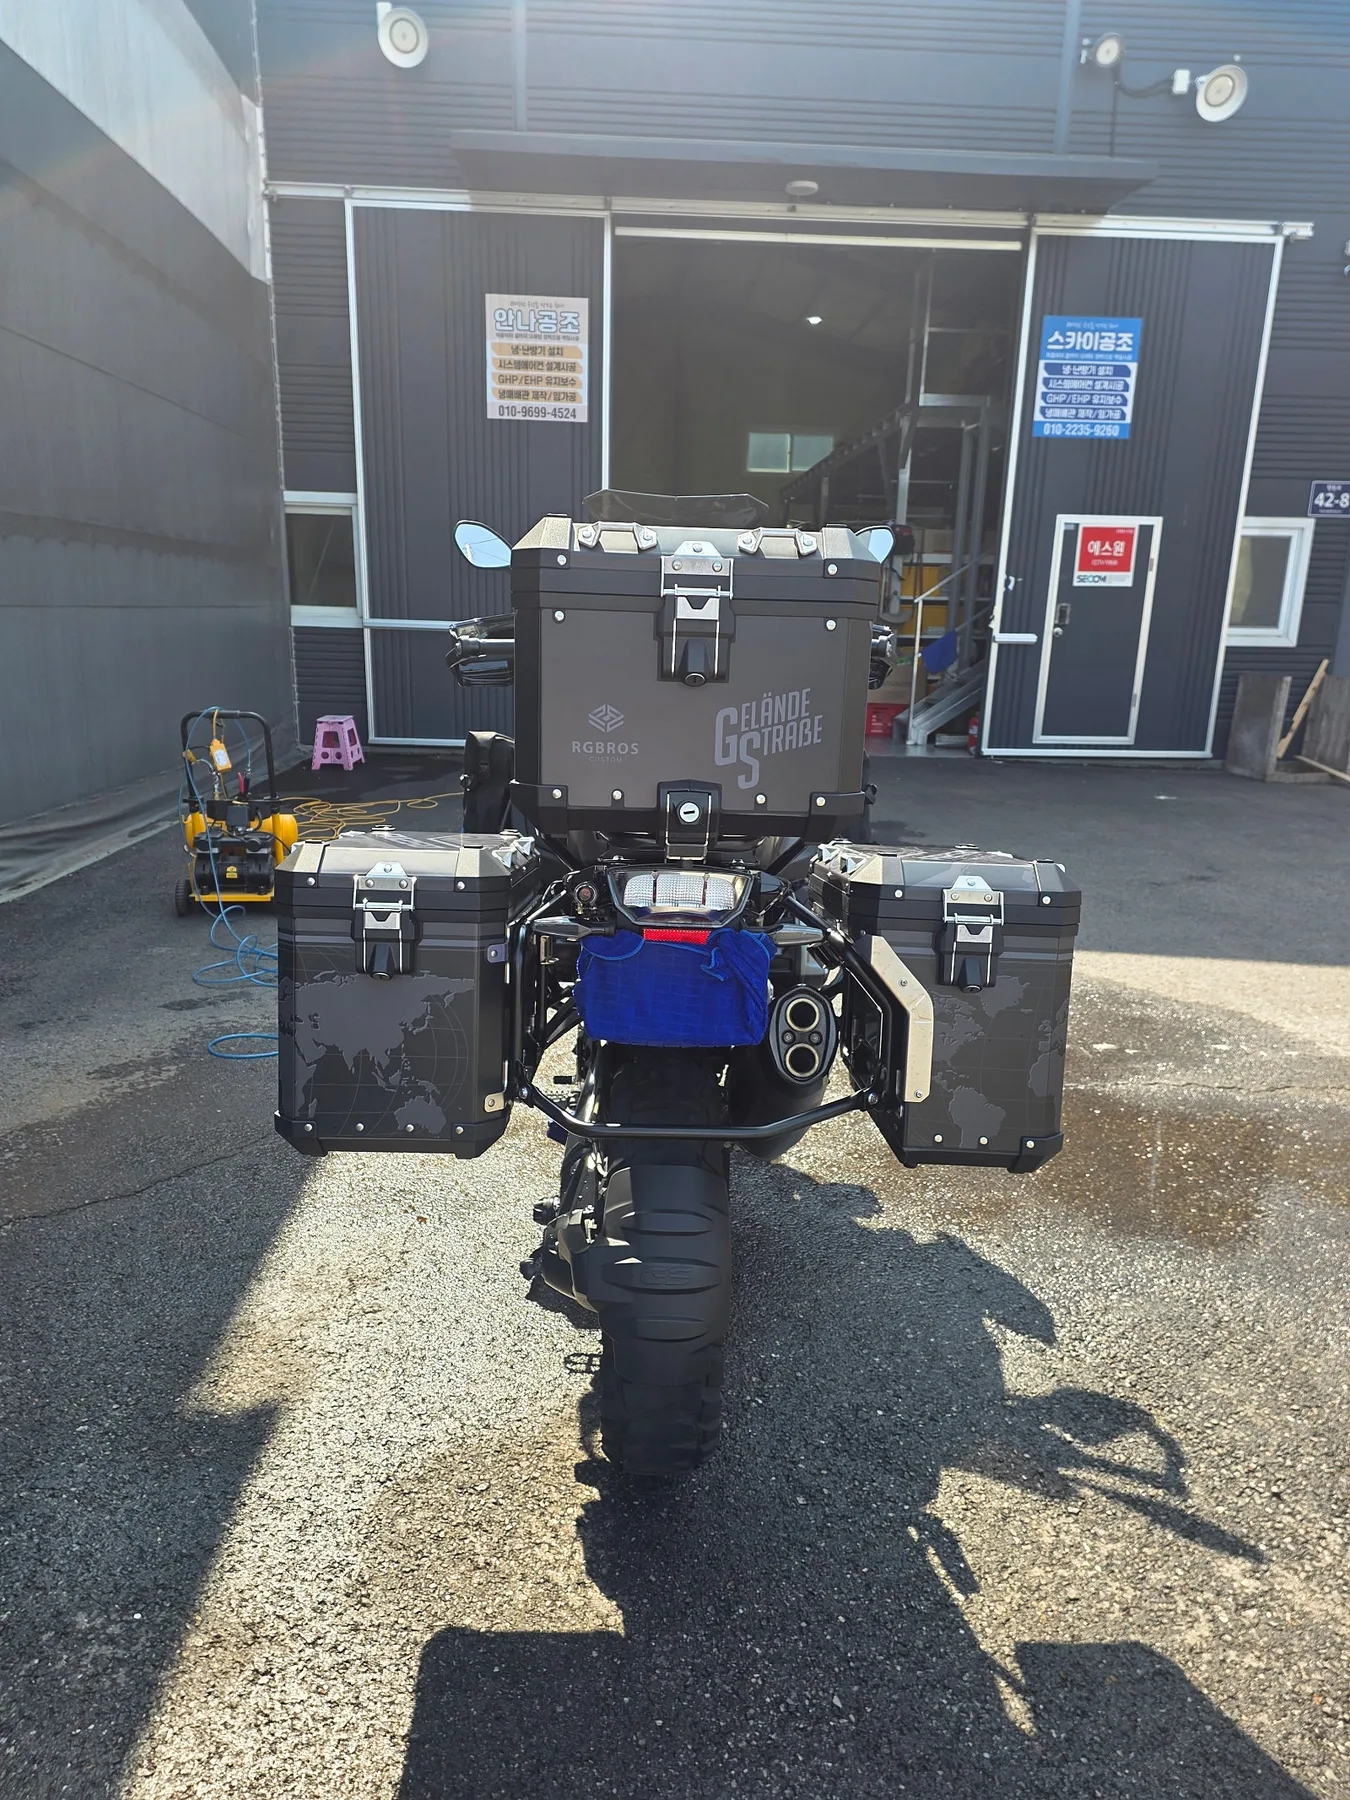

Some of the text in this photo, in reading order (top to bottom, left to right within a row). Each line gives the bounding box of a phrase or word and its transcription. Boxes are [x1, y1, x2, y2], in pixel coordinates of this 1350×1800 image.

[494, 308, 580, 334] 안나공조
[1047, 330, 1134, 351] 스카이공조
[548, 346, 563, 356] 설치
[498, 359, 576, 372] 시스템에어컨 설계시공
[545, 376, 576, 388] 유지보수
[1092, 394, 1122, 405] 유지보수
[498, 404, 577, 419] 010-9699-4524
[1043, 423, 1119, 436] 010-2235-9260
[1313, 492, 1350, 508] 42-8
[1087, 540, 1126, 557] 에스원
[572, 741, 639, 755] RGBROS
